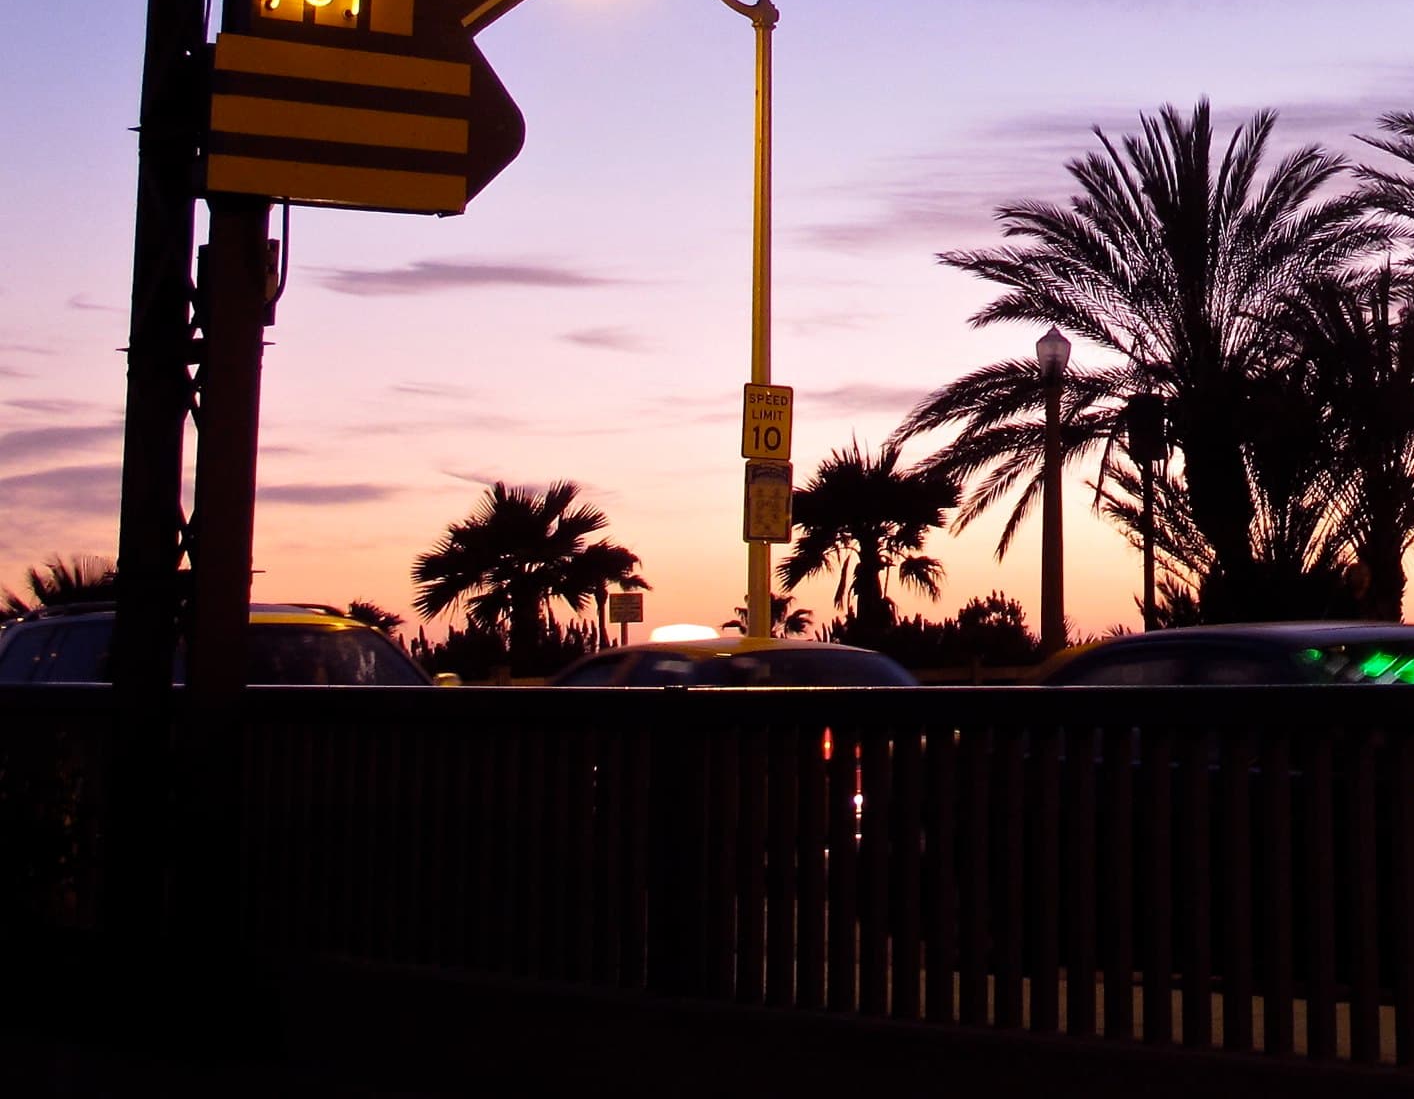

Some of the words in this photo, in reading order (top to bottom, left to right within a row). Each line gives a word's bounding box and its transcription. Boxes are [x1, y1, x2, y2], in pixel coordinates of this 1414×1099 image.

[749, 393, 789, 406] SPEED
[752, 410, 785, 421] LIMIT
[753, 426, 782, 451] 10
